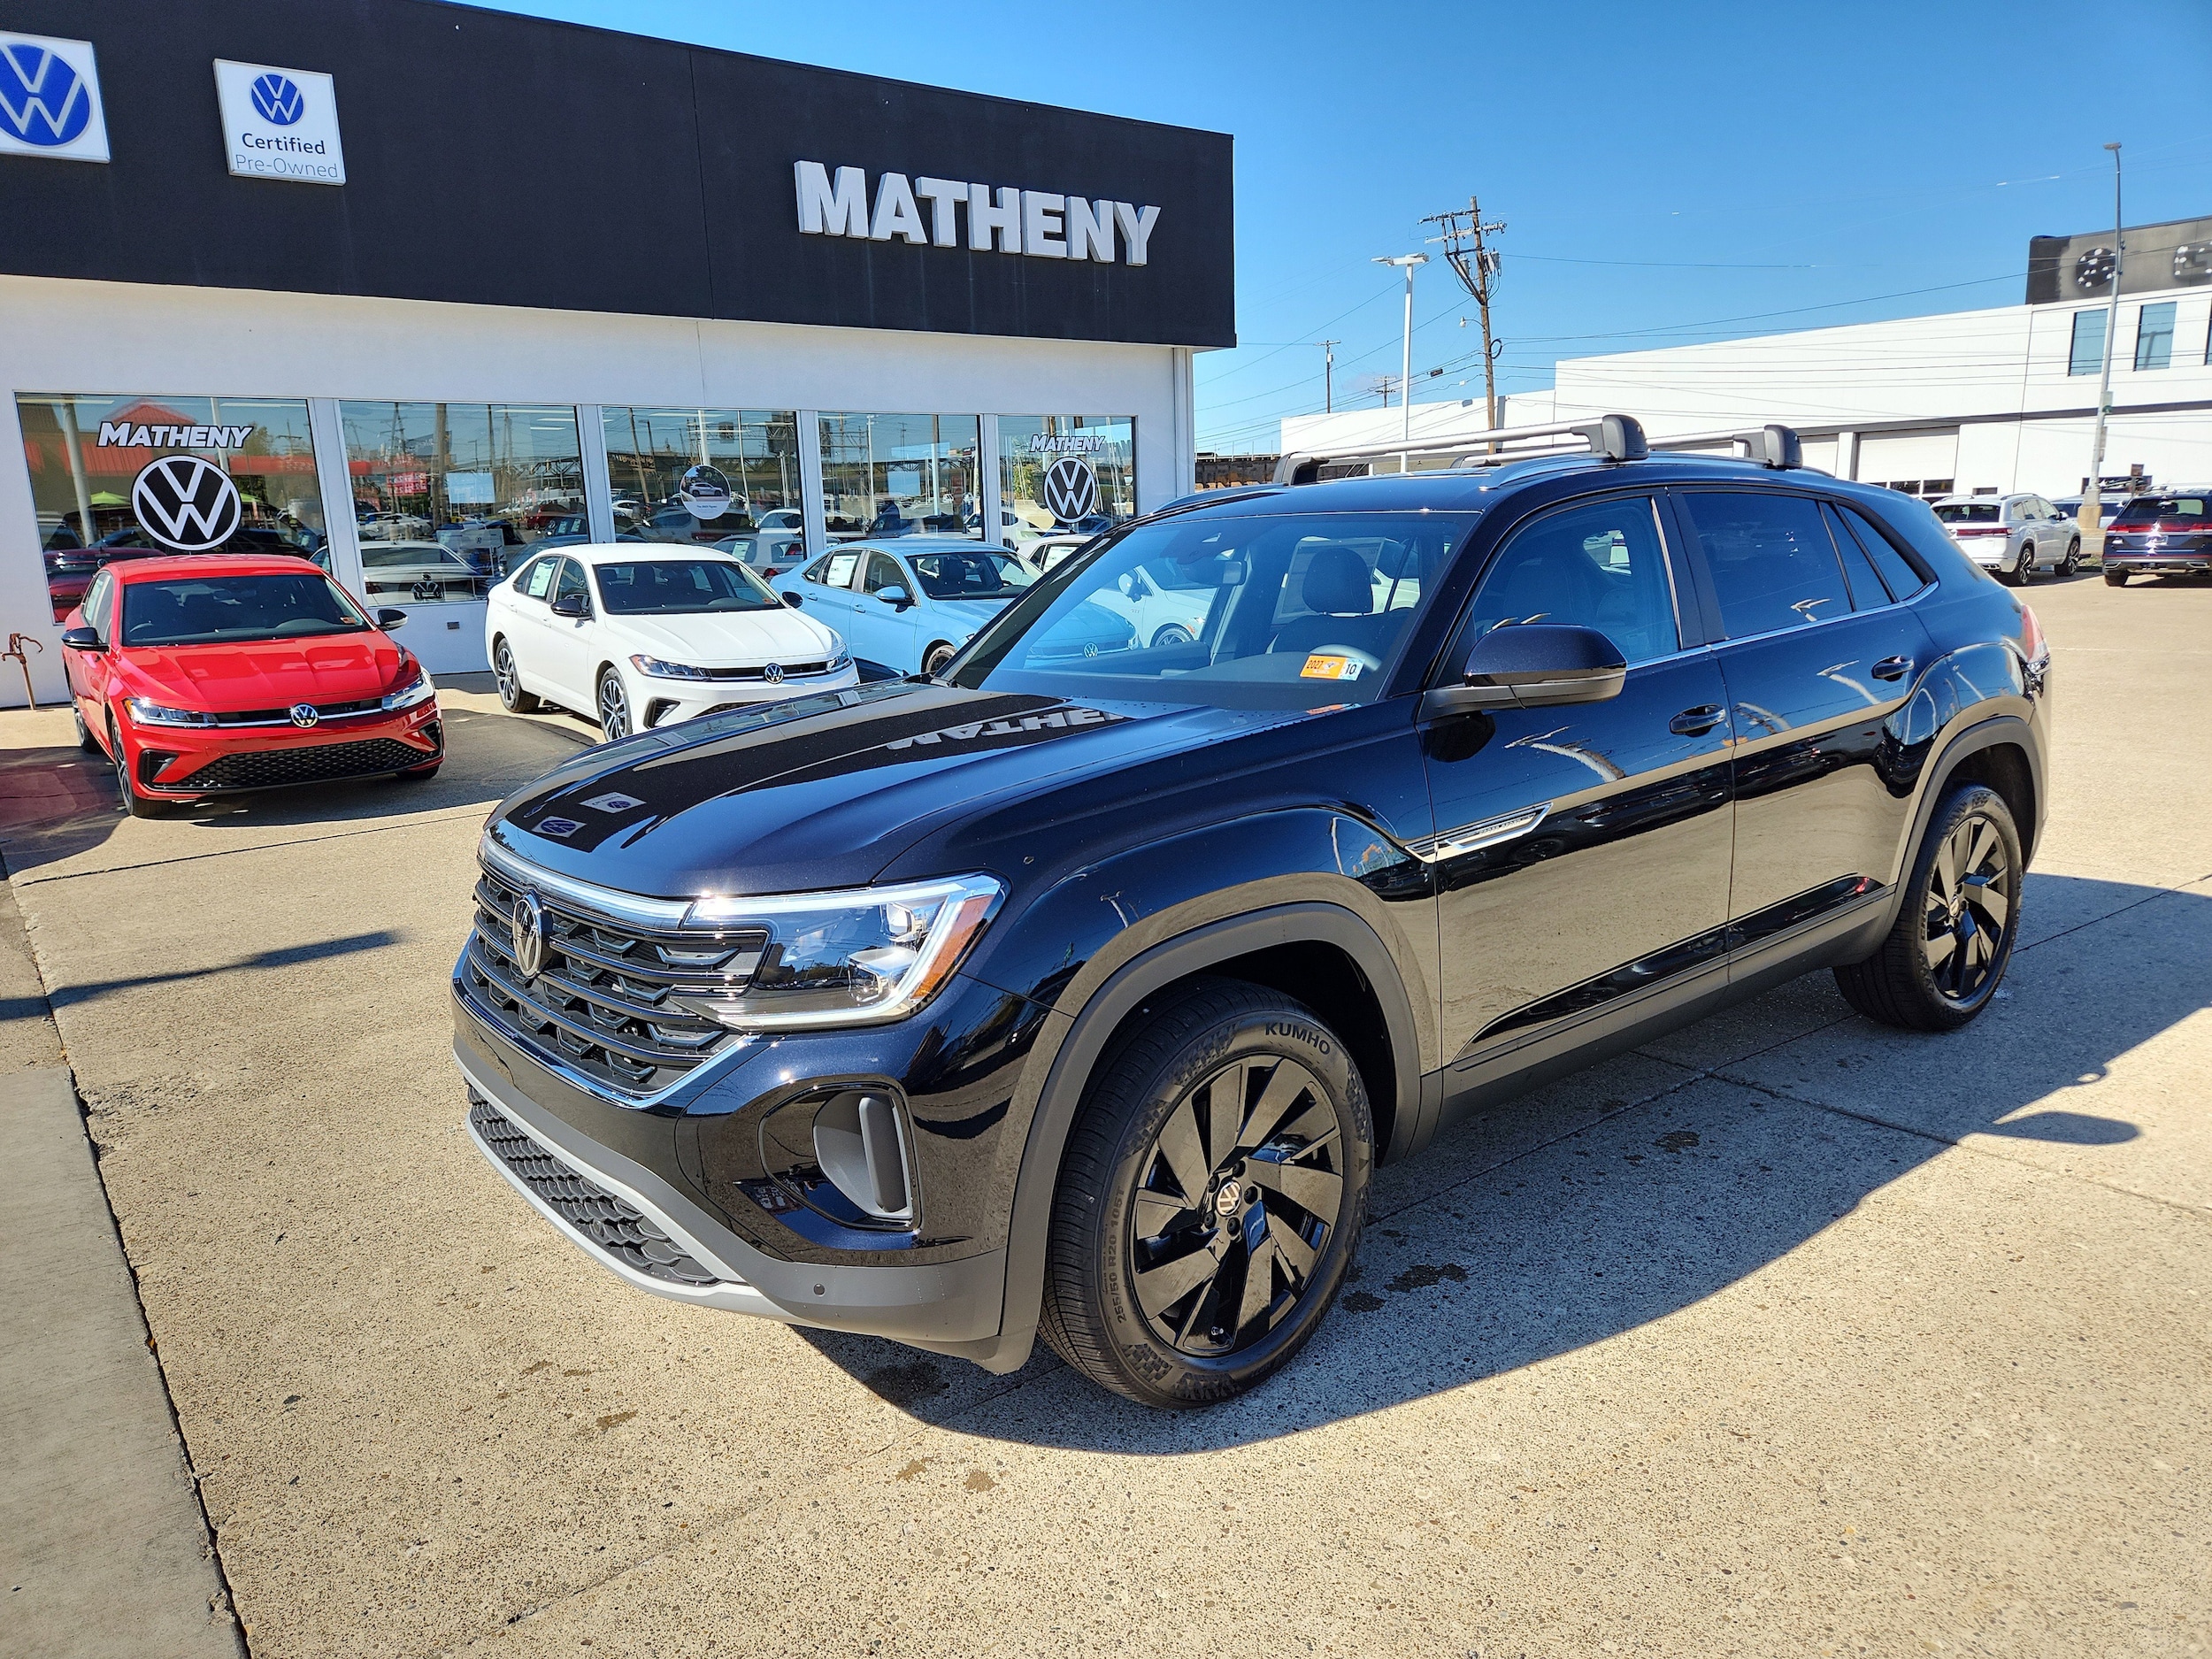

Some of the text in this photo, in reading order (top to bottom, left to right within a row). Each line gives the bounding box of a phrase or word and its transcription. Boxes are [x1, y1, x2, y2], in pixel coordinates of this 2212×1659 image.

[250, 73, 305, 127] VW
[242, 132, 326, 155] Certified
[235, 154, 338, 178] Pre-Owned
[794, 160, 1161, 266] MATHENY
[96, 421, 254, 449] MATHENY
[1029, 434, 1105, 453] MATHENY
[131, 454, 242, 551] VW
[1043, 457, 1097, 524] VW
[1306, 659, 1324, 670] 2027
[1345, 663, 1357, 675] 10
[1264, 1022, 1331, 1055] KUMHO
[1107, 1233, 1118, 1267] R20
[1108, 1272, 1127, 1325] 255/50
